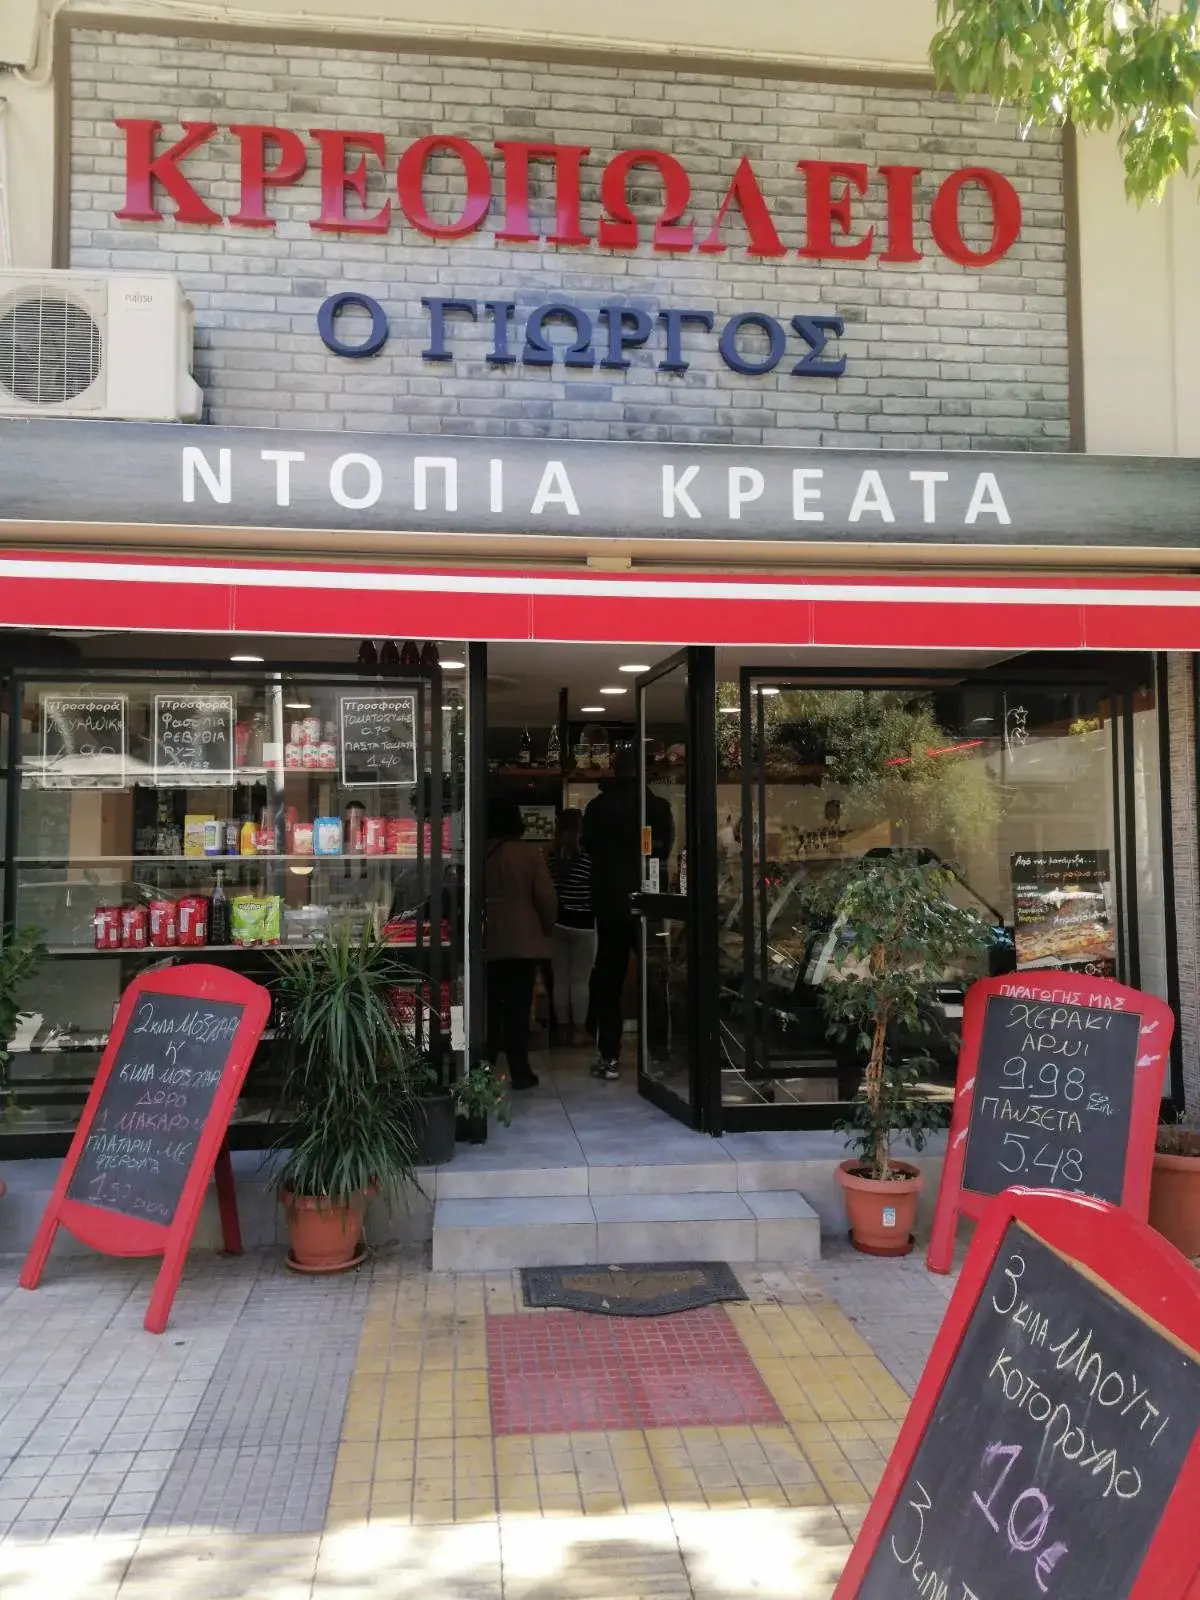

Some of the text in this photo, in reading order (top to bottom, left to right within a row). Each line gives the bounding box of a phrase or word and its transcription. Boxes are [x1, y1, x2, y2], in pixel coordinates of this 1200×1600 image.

[114, 118, 1022, 268] ΚΡΕΟΠΩΛΕΙΟ
[317, 291, 847, 378] Ο ΓΙΩΡΓΟΣ
[181, 446, 1011, 525] ΝΤΟΠΙΑ ΚΡΕΑΤΑ
[344, 700, 411, 711] Προσφορά
[1000, 984, 1126, 1009] ΠΑΡΑΓΩΓΗΣ ΜΑΣ
[1005, 1004, 1112, 1030] ΧΕΡΑΚΙ
[1021, 1032, 1089, 1057] ΑΡΝΙ
[999, 1056, 1085, 1101] 9.98
[997, 1133, 1083, 1184] 5.48
[1050, 1328, 1169, 1446] ΜΠΟΥΤΙ
